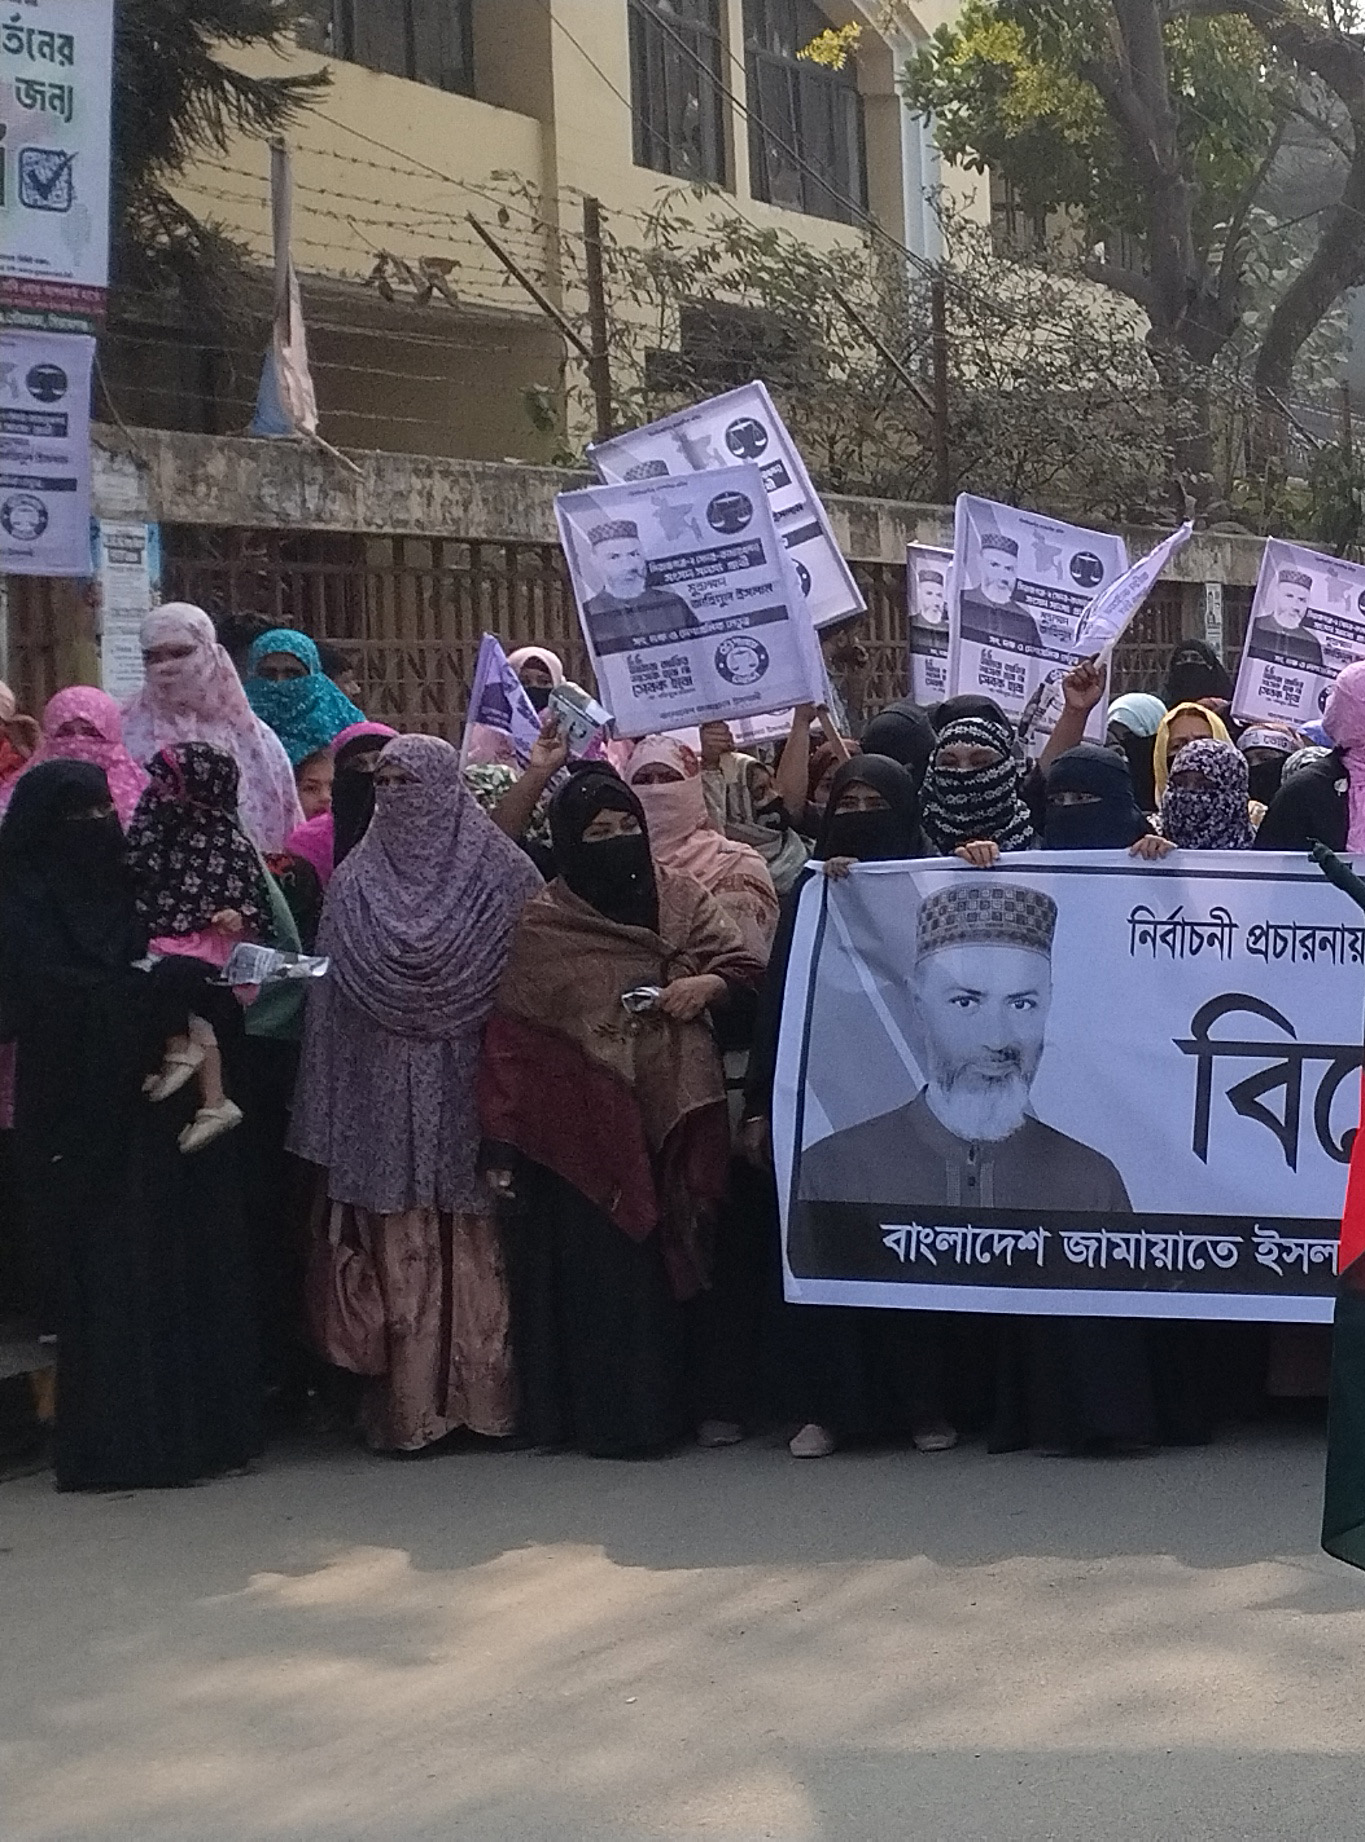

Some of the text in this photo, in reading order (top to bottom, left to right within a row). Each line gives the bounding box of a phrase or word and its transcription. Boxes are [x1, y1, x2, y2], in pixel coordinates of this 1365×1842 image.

[2, 12, 74, 66] র্তনের
[15, 76, 74, 123] জন্য
[1126, 905, 1240, 961] নির্বাচনী
[879, 1221, 1052, 1267] বাংলাদেশ
[1059, 1227, 1244, 1272] জামায়াতে
